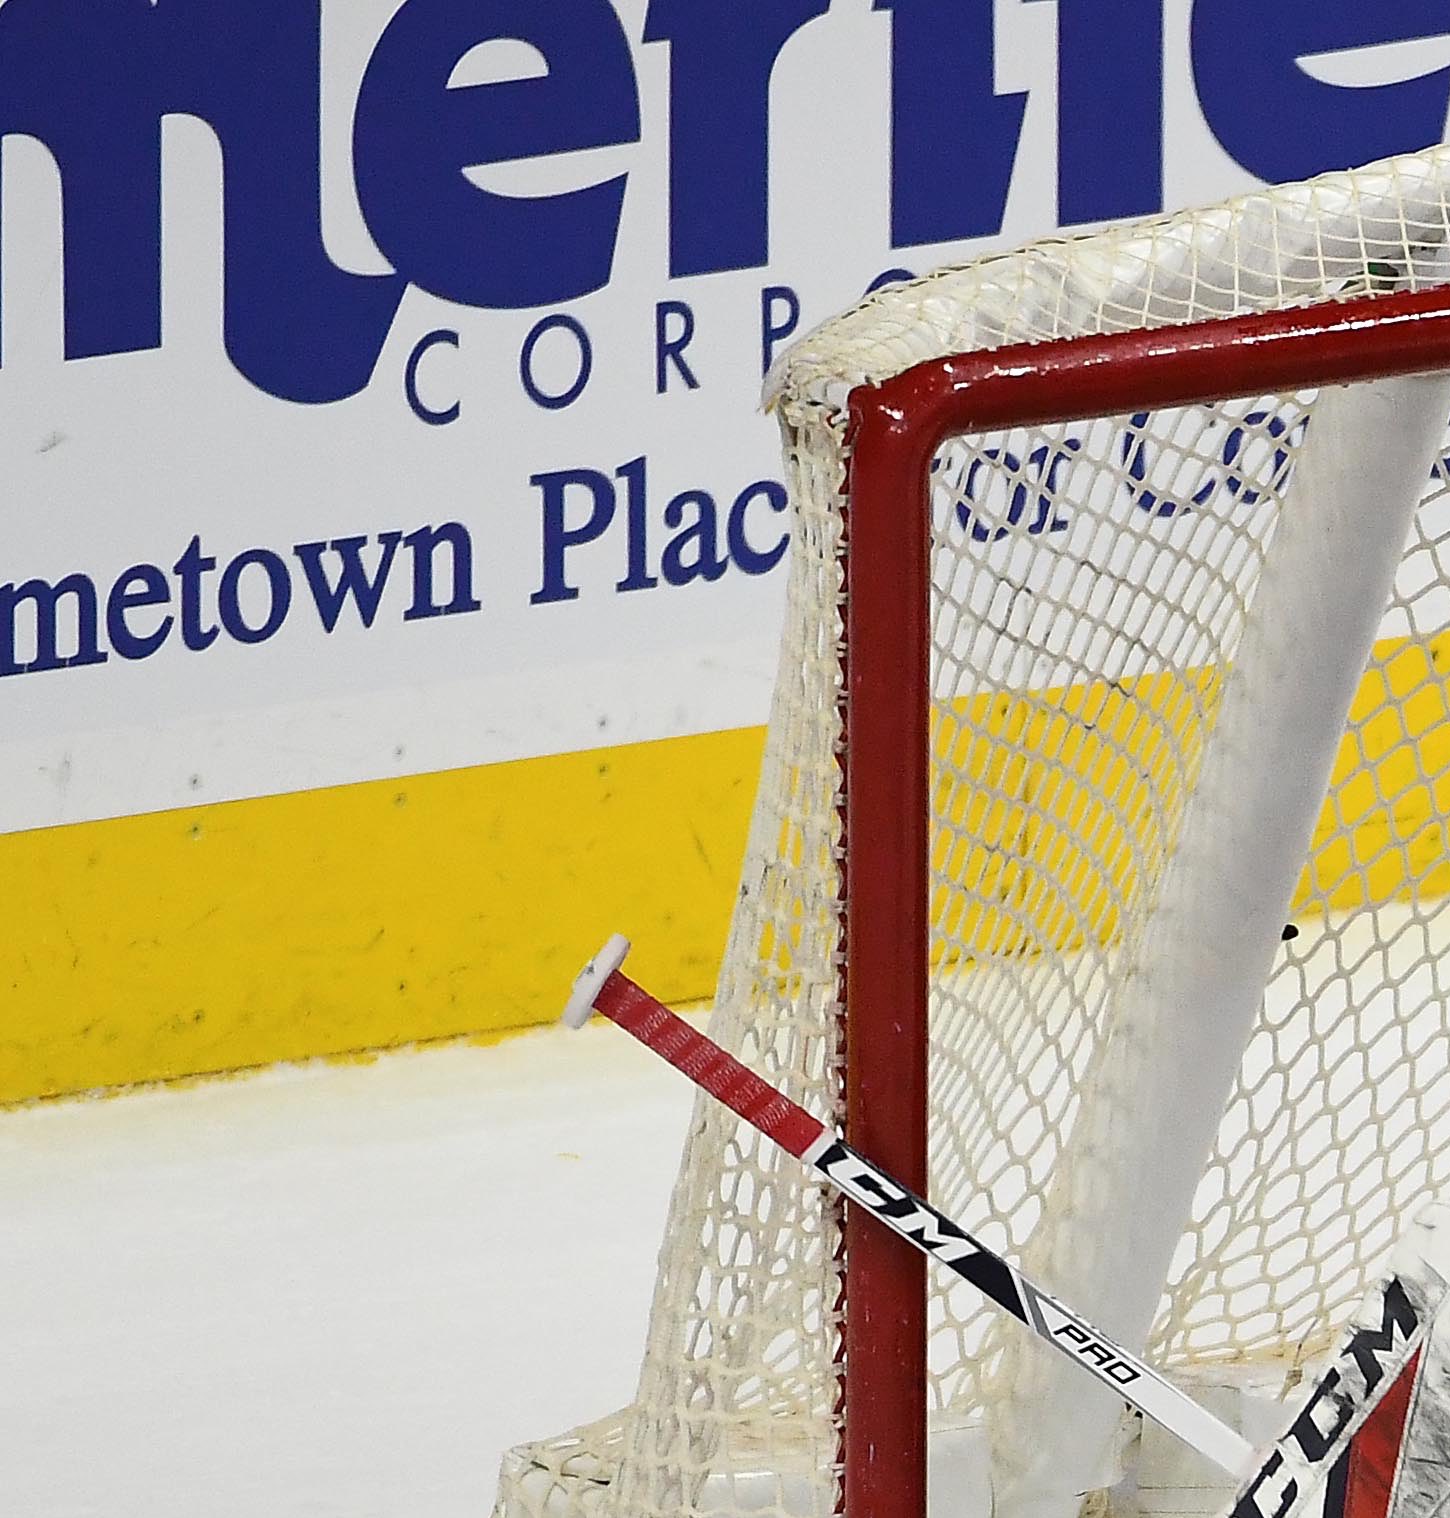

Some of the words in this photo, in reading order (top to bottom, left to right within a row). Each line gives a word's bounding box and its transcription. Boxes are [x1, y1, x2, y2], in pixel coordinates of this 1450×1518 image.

[404, 264, 925, 428] CORP
[931, 438, 1084, 545] or
[1053, 1324, 1143, 1386] PRO
